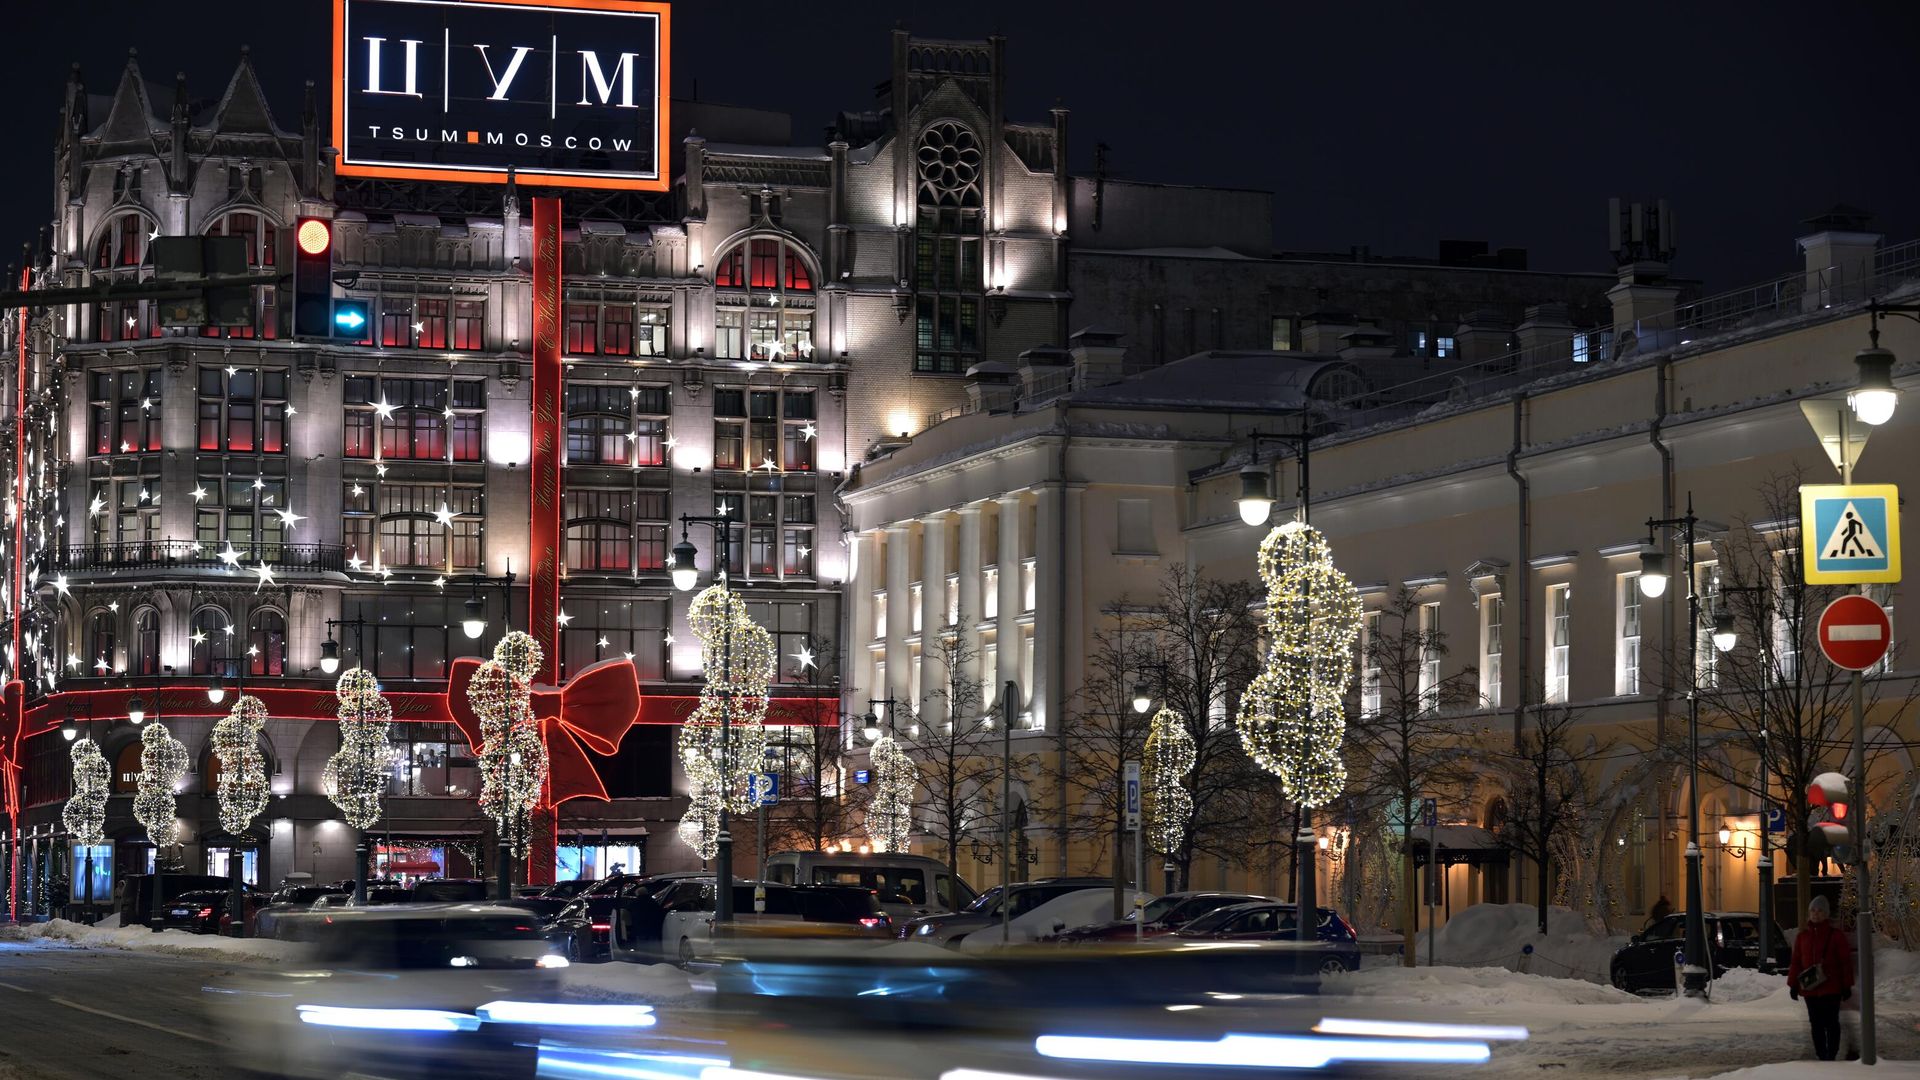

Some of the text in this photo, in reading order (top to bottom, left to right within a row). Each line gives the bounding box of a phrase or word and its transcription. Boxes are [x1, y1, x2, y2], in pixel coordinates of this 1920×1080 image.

[369, 126, 632, 151] TSUM MOSCOW
[539, 223, 556, 272] Годом
[538, 274, 556, 334] Новым
[535, 389, 556, 511] Happy New Year
[535, 545, 553, 594] Годом
[395, 695, 432, 716] Year
[1130, 784, 1137, 809] P
[1767, 808, 1781, 829] P
